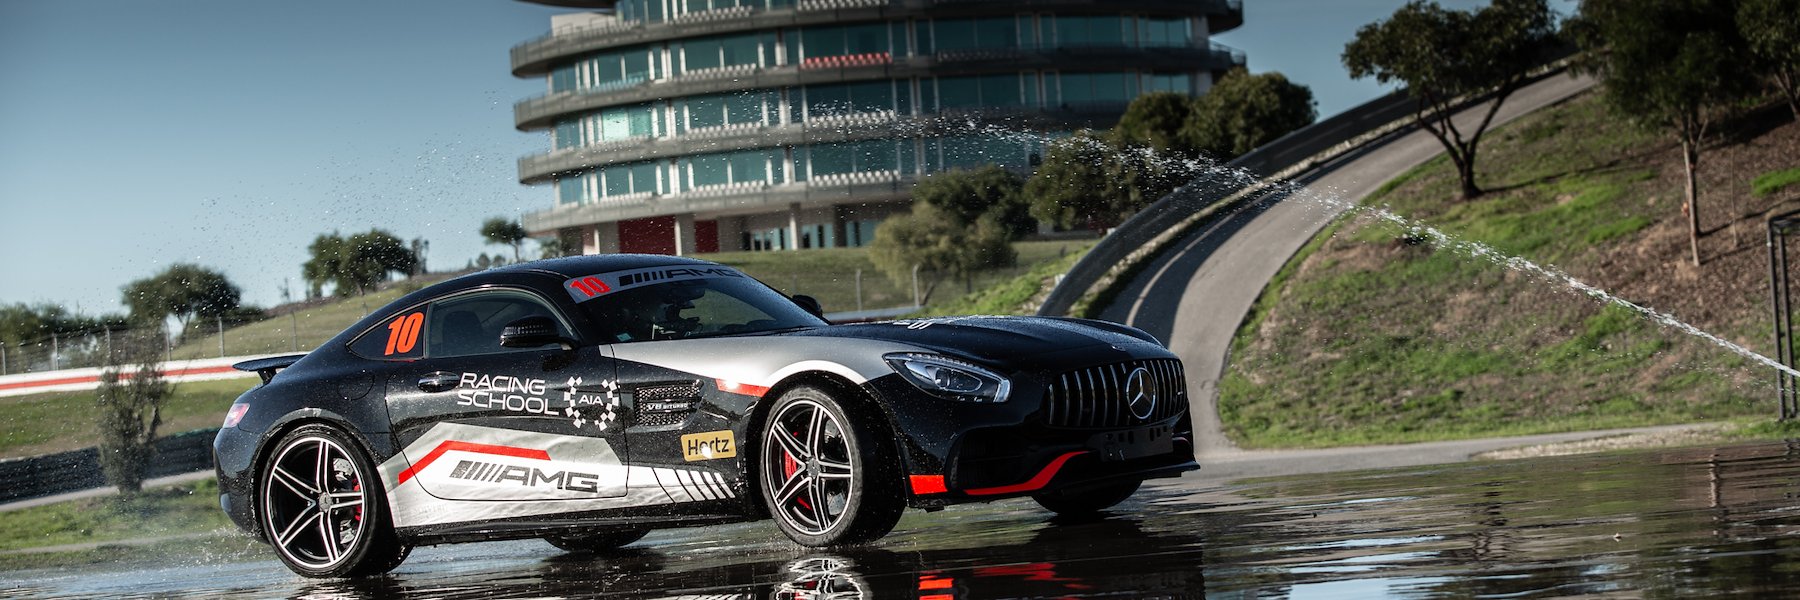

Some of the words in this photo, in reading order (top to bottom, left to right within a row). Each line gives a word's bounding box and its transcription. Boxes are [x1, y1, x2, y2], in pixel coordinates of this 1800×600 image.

[569, 276, 612, 298] 10
[666, 268, 745, 279] AMG
[384, 311, 425, 356] 10
[459, 372, 546, 396] RACING
[457, 389, 560, 416] SCHOOL
[578, 394, 604, 406] AIA
[647, 402, 662, 411] V8
[495, 465, 599, 493] AMG
